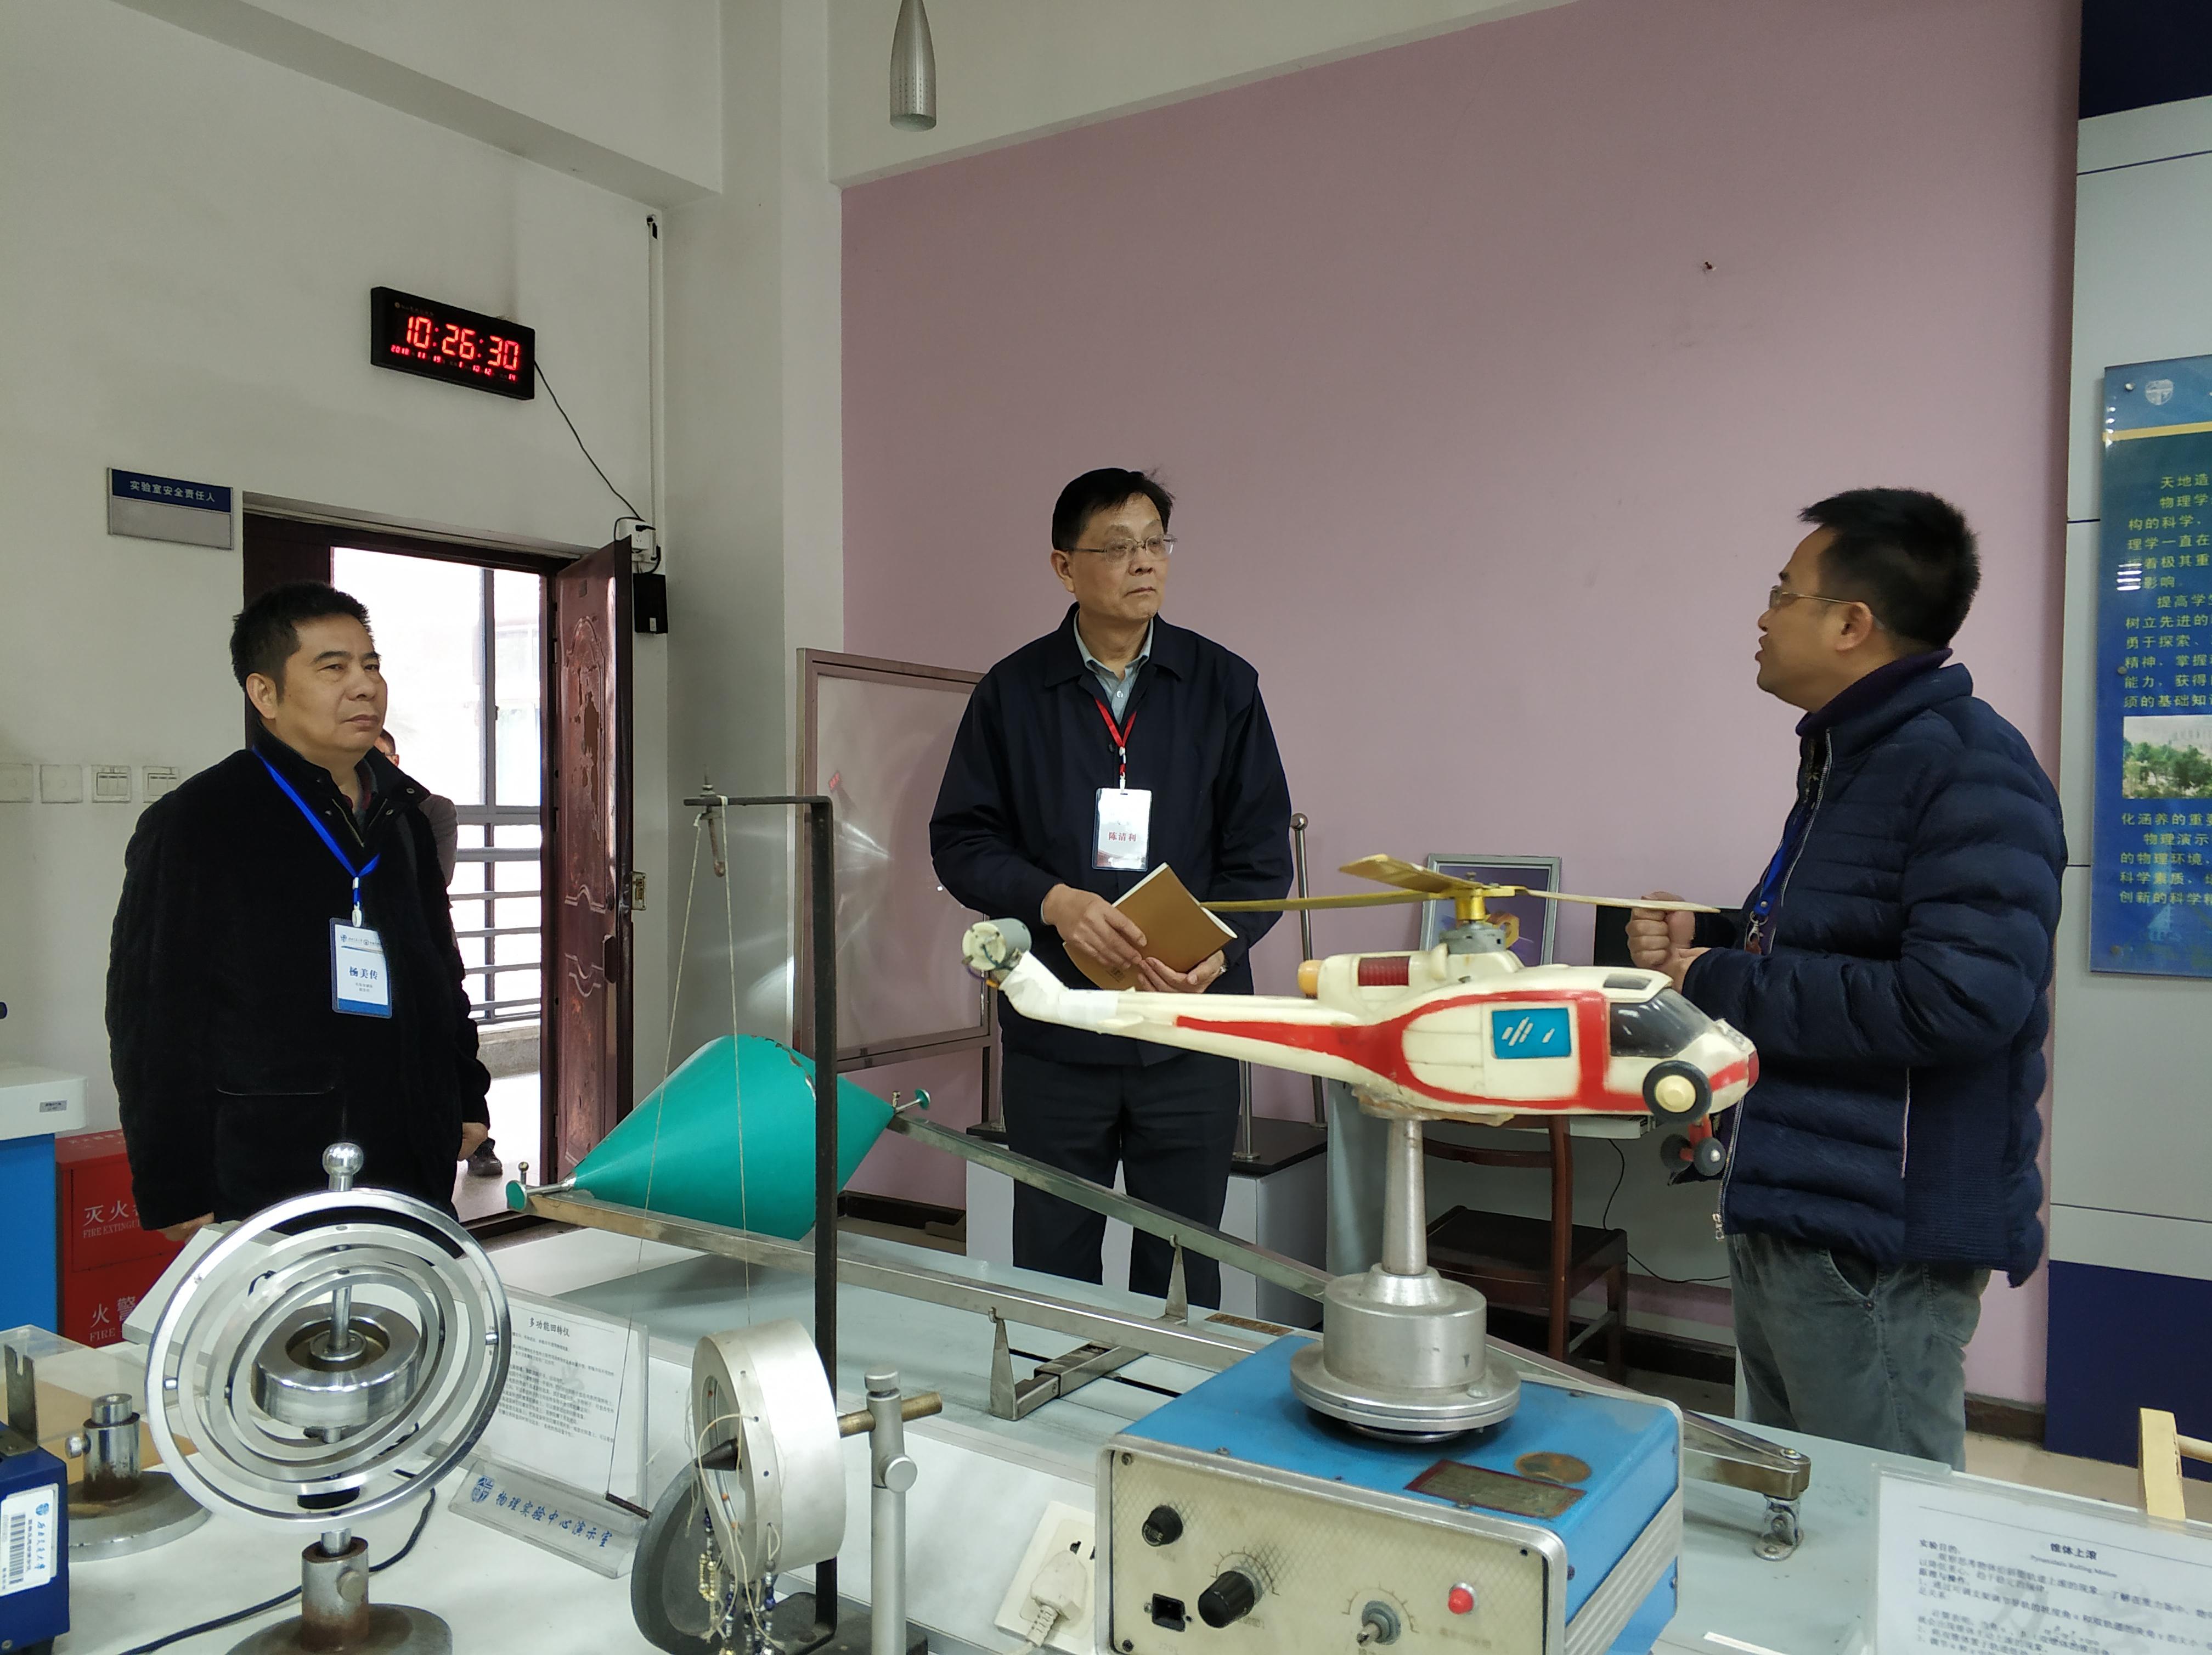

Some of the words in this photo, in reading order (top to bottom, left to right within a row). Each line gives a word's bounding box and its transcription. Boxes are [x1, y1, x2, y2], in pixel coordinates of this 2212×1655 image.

[406, 316, 520, 371] 10:26:30
[2160, 473, 2209, 489] 天地造
[129, 480, 216, 503] 实验室安全责任人
[2159, 493, 2212, 509] 物理学
[2127, 533, 2210, 551] 理学一直在
[2126, 553, 2210, 570] 着极其重
[2125, 614, 2212, 629] 树立先进的
[2126, 634, 2212, 650] 勇于探索、
[2124, 654, 2212, 669] 精神，掌握
[2124, 673, 2212, 689] 能力，获得
[2124, 694, 2212, 708] 须的基础知
[2143, 832, 2212, 846] 物理演示
[83, 1227, 102, 1239] FIRE
[89, 1327, 116, 1342] FIRE
[528, 1316, 571, 1338] 多功能回转仪
[495, 1490, 613, 1548] 物理实验中心演示室
[1143, 1523, 1164, 1542] FUSE
